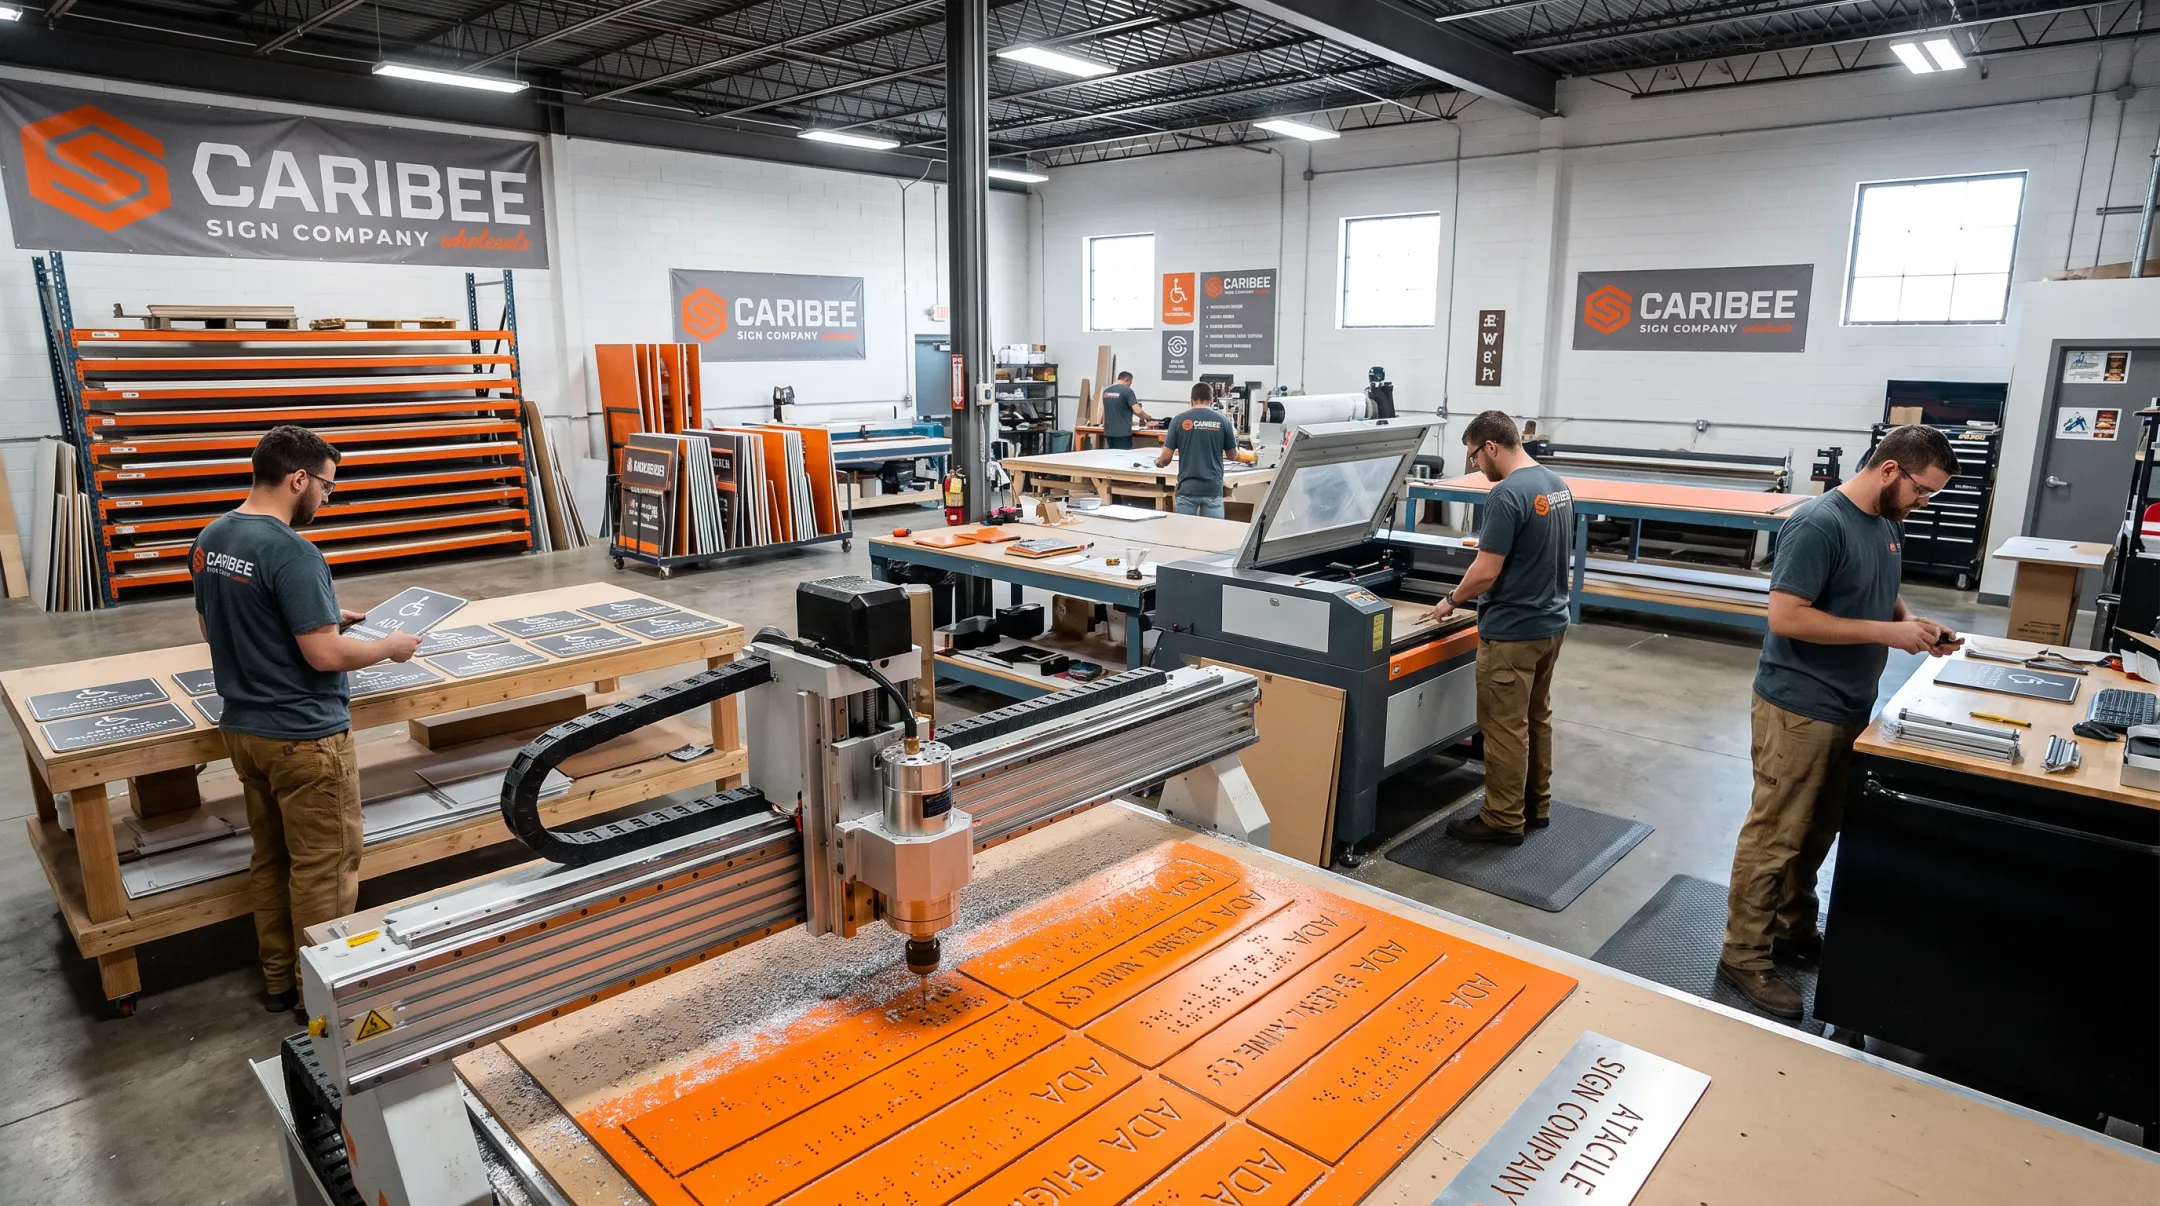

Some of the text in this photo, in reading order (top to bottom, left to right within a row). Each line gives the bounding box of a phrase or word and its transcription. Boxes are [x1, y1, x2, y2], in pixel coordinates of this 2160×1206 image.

[192, 141, 532, 225] CARIBEE
[206, 218, 279, 240] SIGN
[293, 224, 430, 248] COMPANY
[1224, 276, 1270, 290] CARIBEE
[735, 297, 857, 328] CARIBEE
[1640, 290, 1798, 320] CARIBEE
[737, 331, 763, 340] SIGN
[767, 331, 818, 340] COMPANY
[1640, 324, 1669, 334] SIGN
[1673, 324, 1738, 334] COMPANY
[375, 618, 406, 631] ADA
[1167, 871, 1215, 897] ADA
[1209, 889, 1270, 917] ADA
[1282, 914, 1340, 945] ADA
[1349, 938, 1410, 974] ADA
[1440, 972, 1499, 1010] ADA
[1030, 1056, 1109, 1106] ADA
[1100, 1097, 1183, 1153] ADA
[1490, 1057, 1626, 1206] SIGN COMPANY
[1560, 1103, 1644, 1196] ATACILE
[1200, 1147, 1287, 1206] ADA
